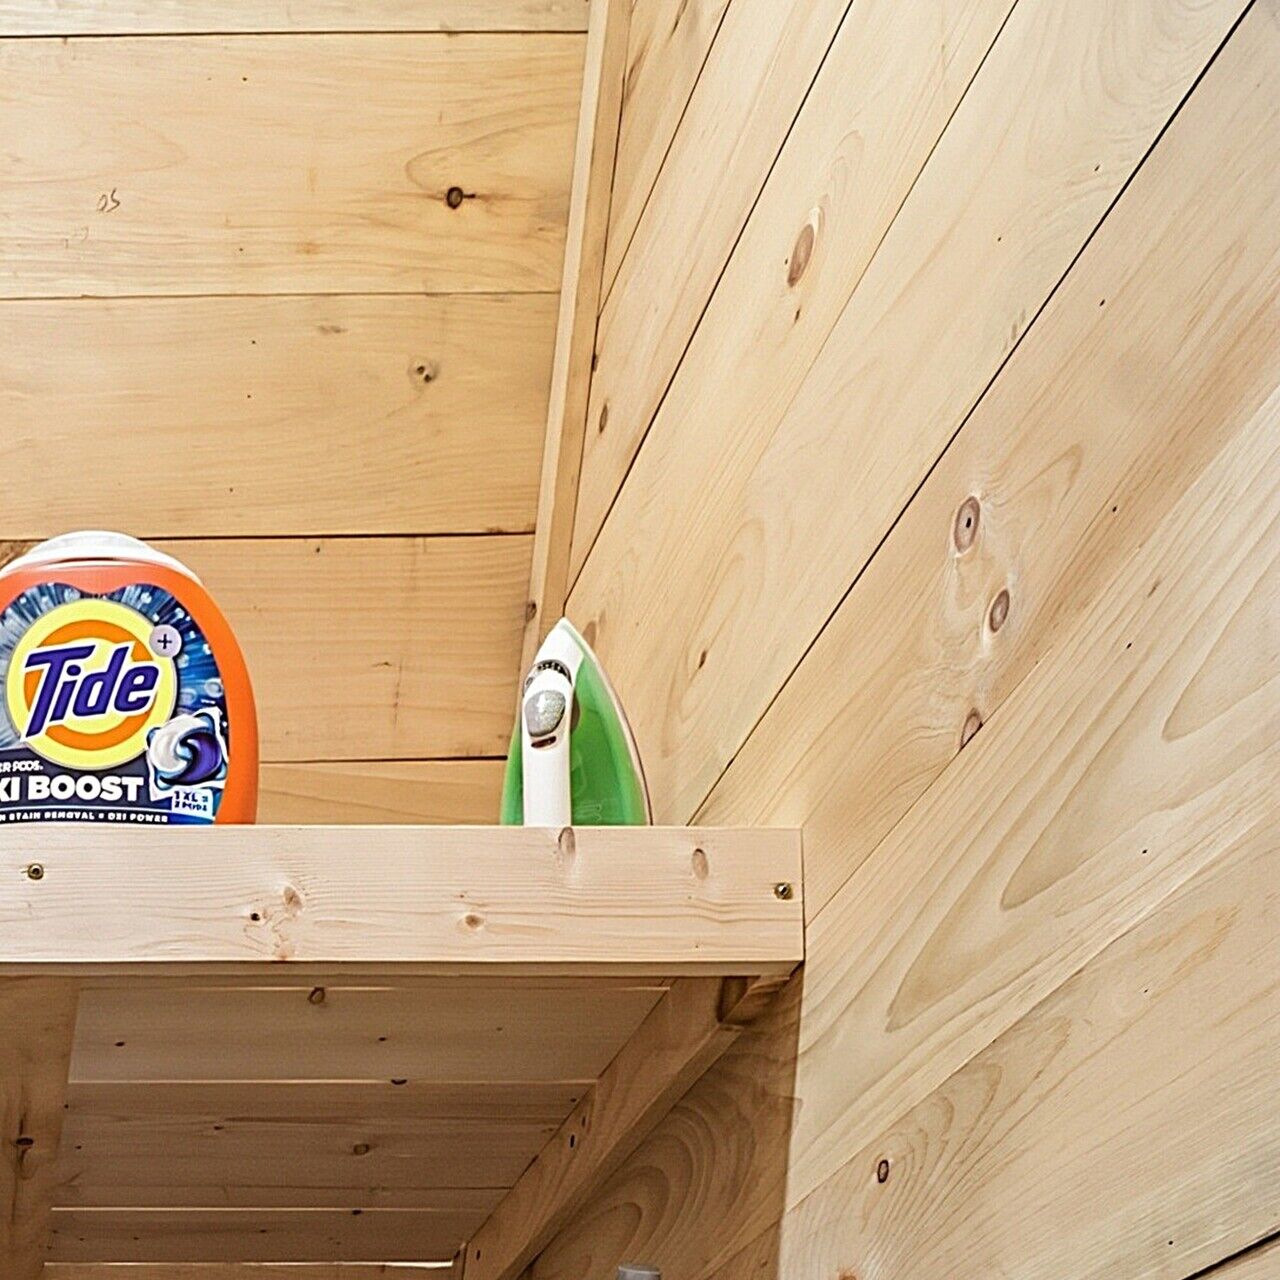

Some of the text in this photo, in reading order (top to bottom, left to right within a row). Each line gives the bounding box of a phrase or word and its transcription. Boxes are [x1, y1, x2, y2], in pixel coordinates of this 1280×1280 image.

[25, 645, 159, 738] Tide
[27, 774, 144, 802] BOOST
[183, 791, 199, 802] XL
[44, 811, 95, 820] REMOVAL
[107, 812, 127, 821] OXI
[130, 813, 168, 823] POWER
